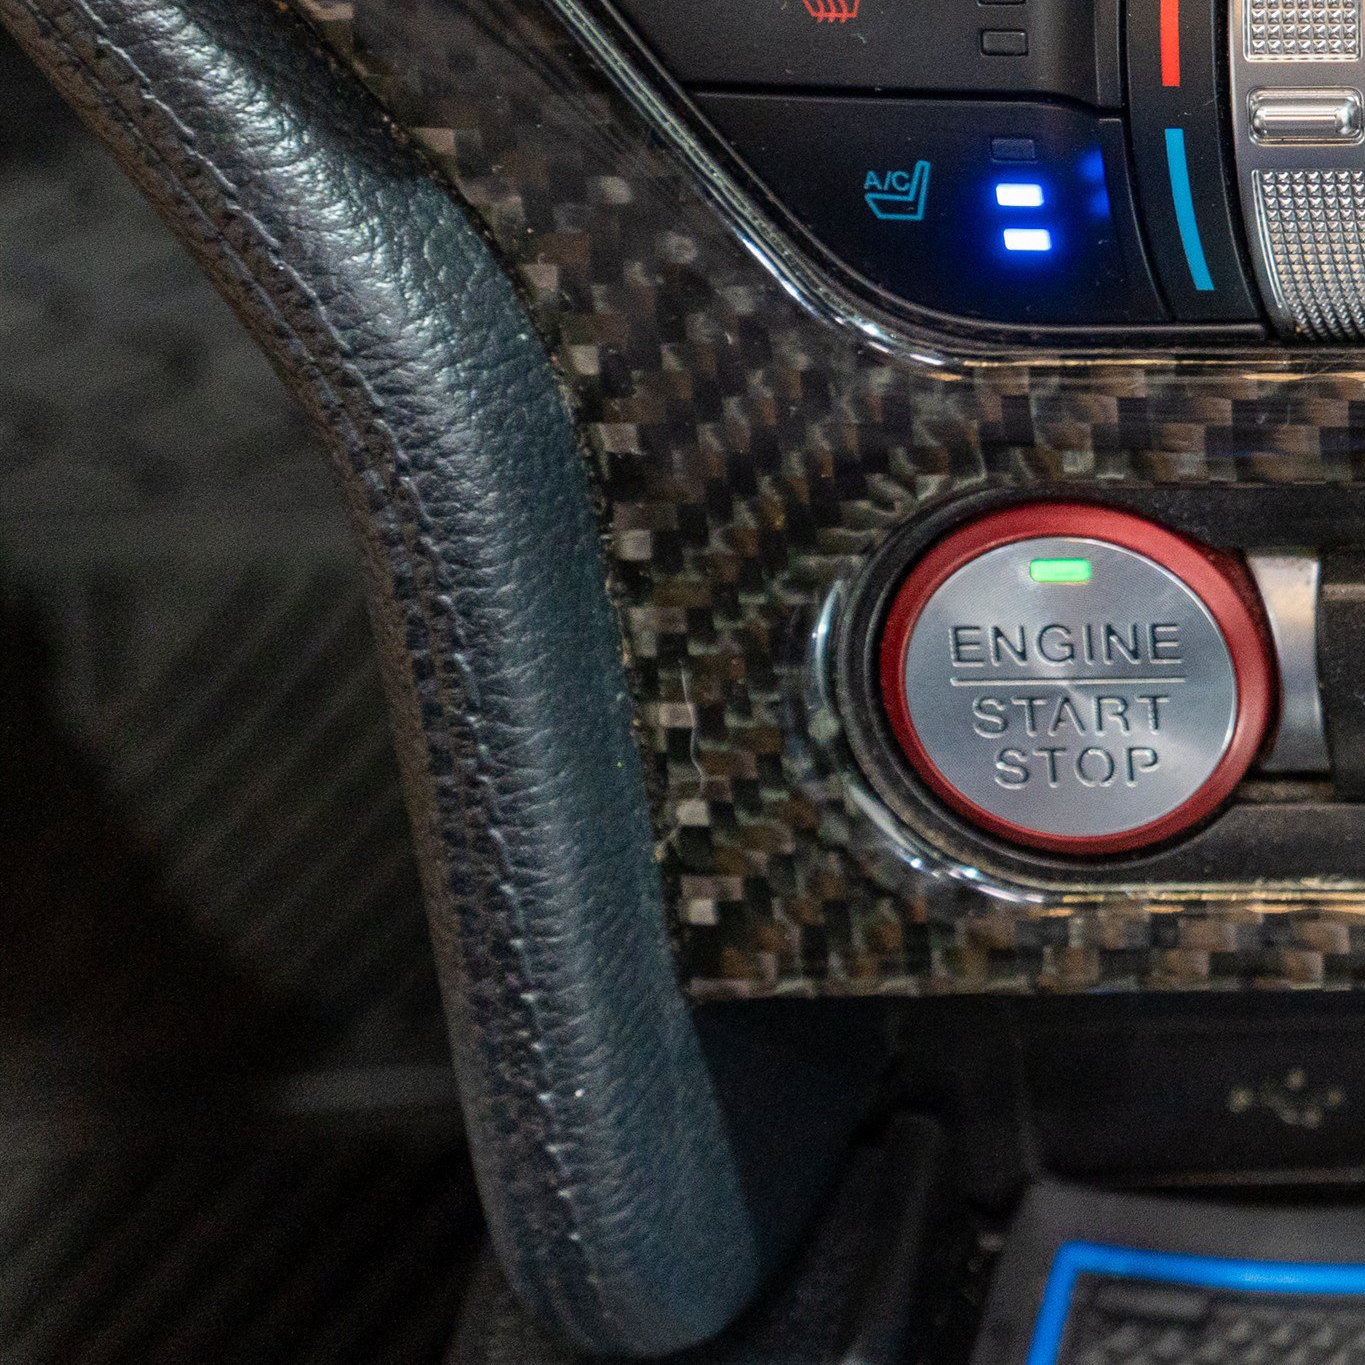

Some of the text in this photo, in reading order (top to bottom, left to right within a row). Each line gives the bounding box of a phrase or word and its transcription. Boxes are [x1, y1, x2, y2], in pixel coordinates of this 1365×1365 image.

[864, 171, 910, 193] A/C
[950, 624, 1182, 668] ENGINE
[972, 695, 1170, 737] START
[994, 747, 1160, 790] STOP
